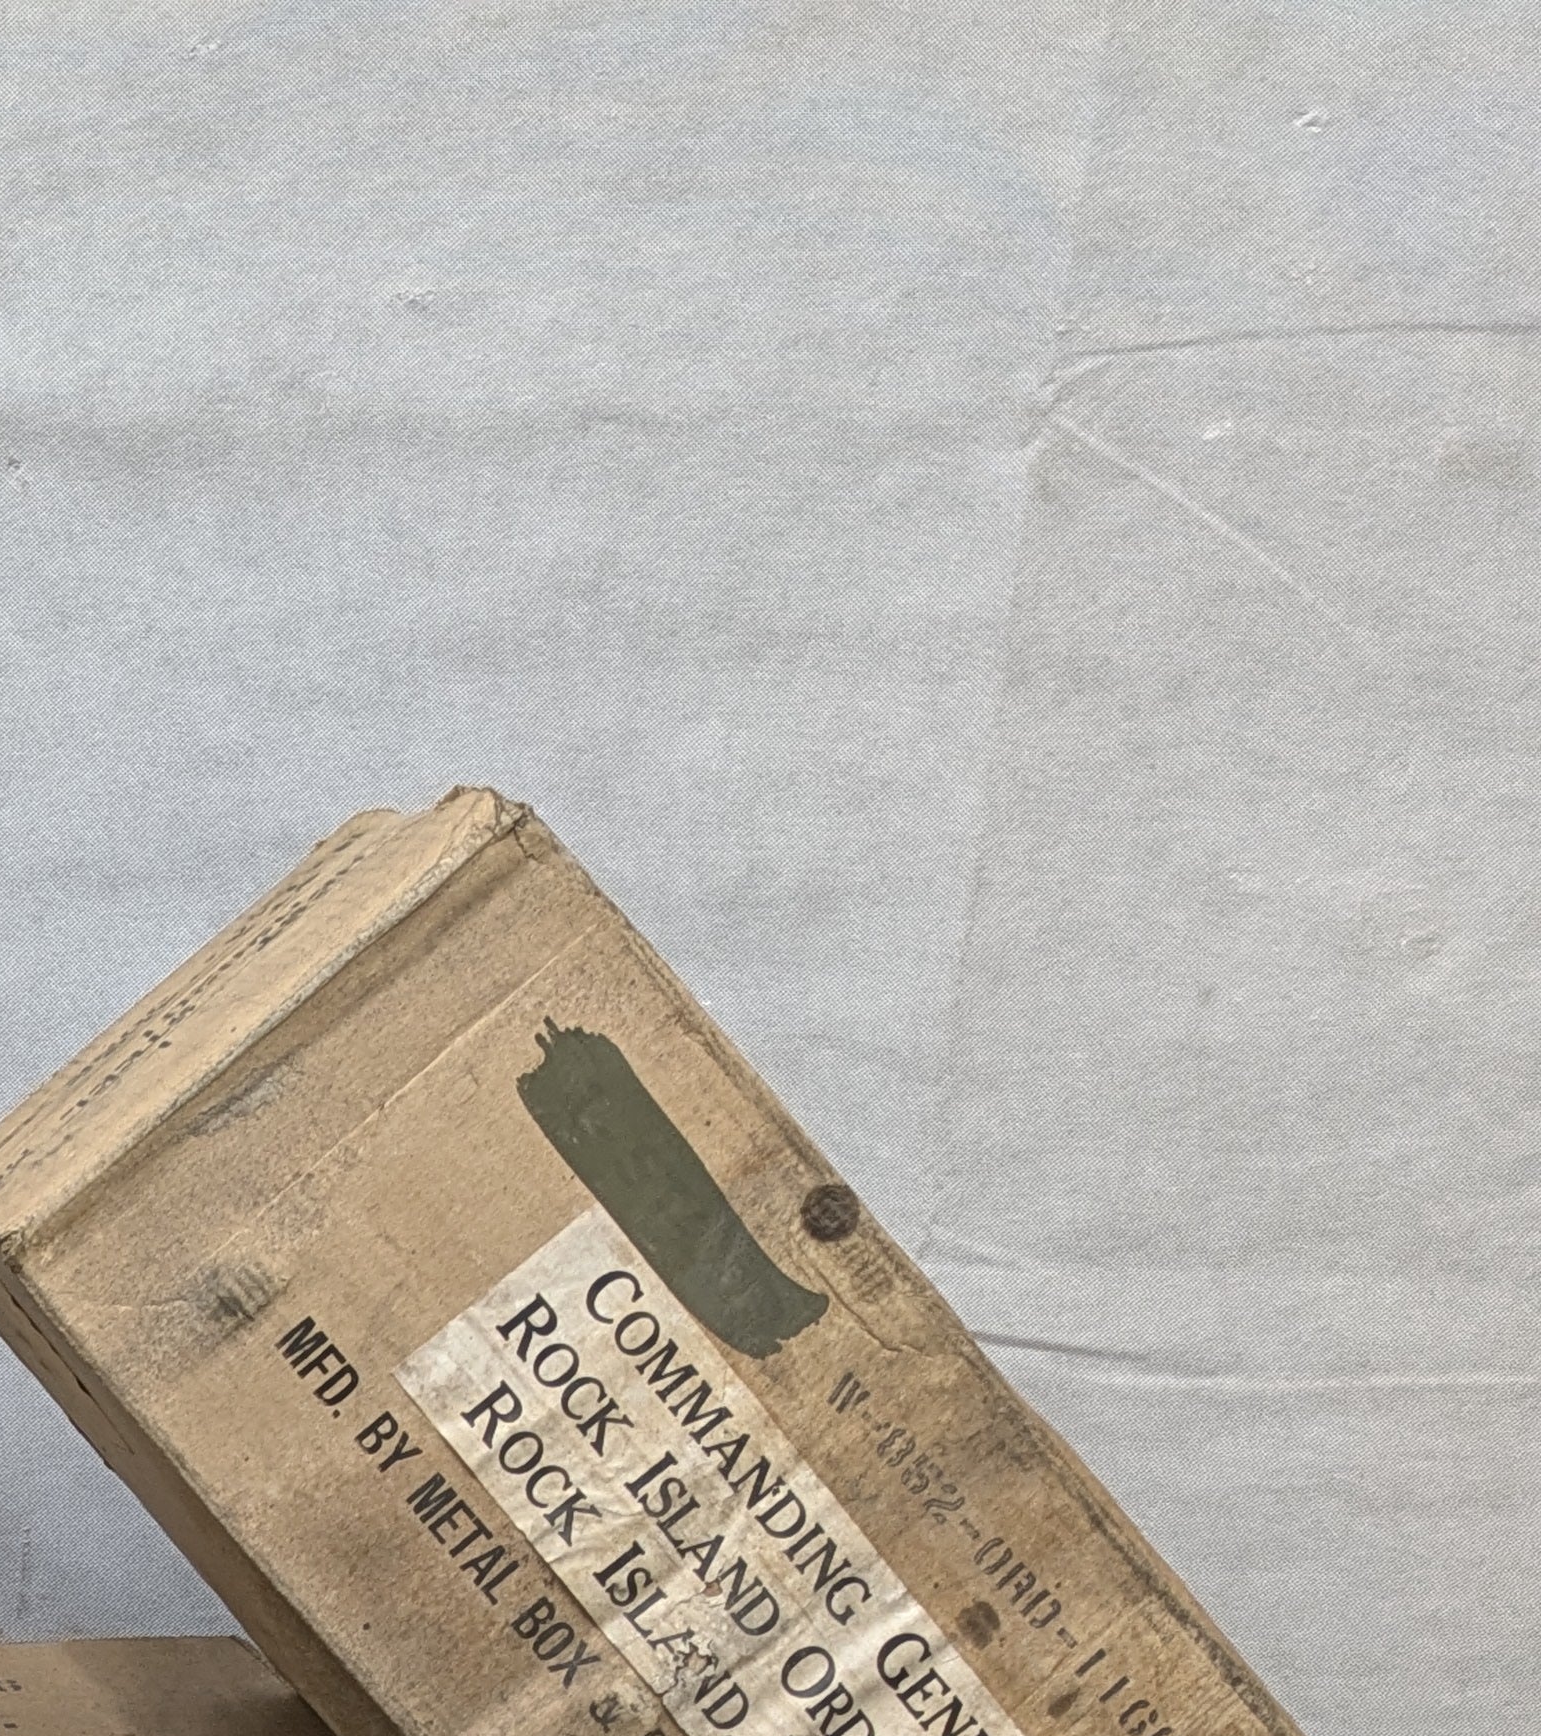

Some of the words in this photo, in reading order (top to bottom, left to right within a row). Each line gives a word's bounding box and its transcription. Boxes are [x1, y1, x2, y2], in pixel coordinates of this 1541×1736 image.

[274, 1316, 360, 1419] MFD.
[354, 1410, 423, 1473] BY
[405, 1471, 521, 1607] METAL
[510, 1595, 601, 1690] BOX
[589, 1698, 619, 1734] &
[461, 1380, 603, 1547] ROCK
[495, 1293, 635, 1457] ROCK
[625, 1450, 781, 1637] ISLAND
[586, 1269, 873, 1626] COMMANDING
